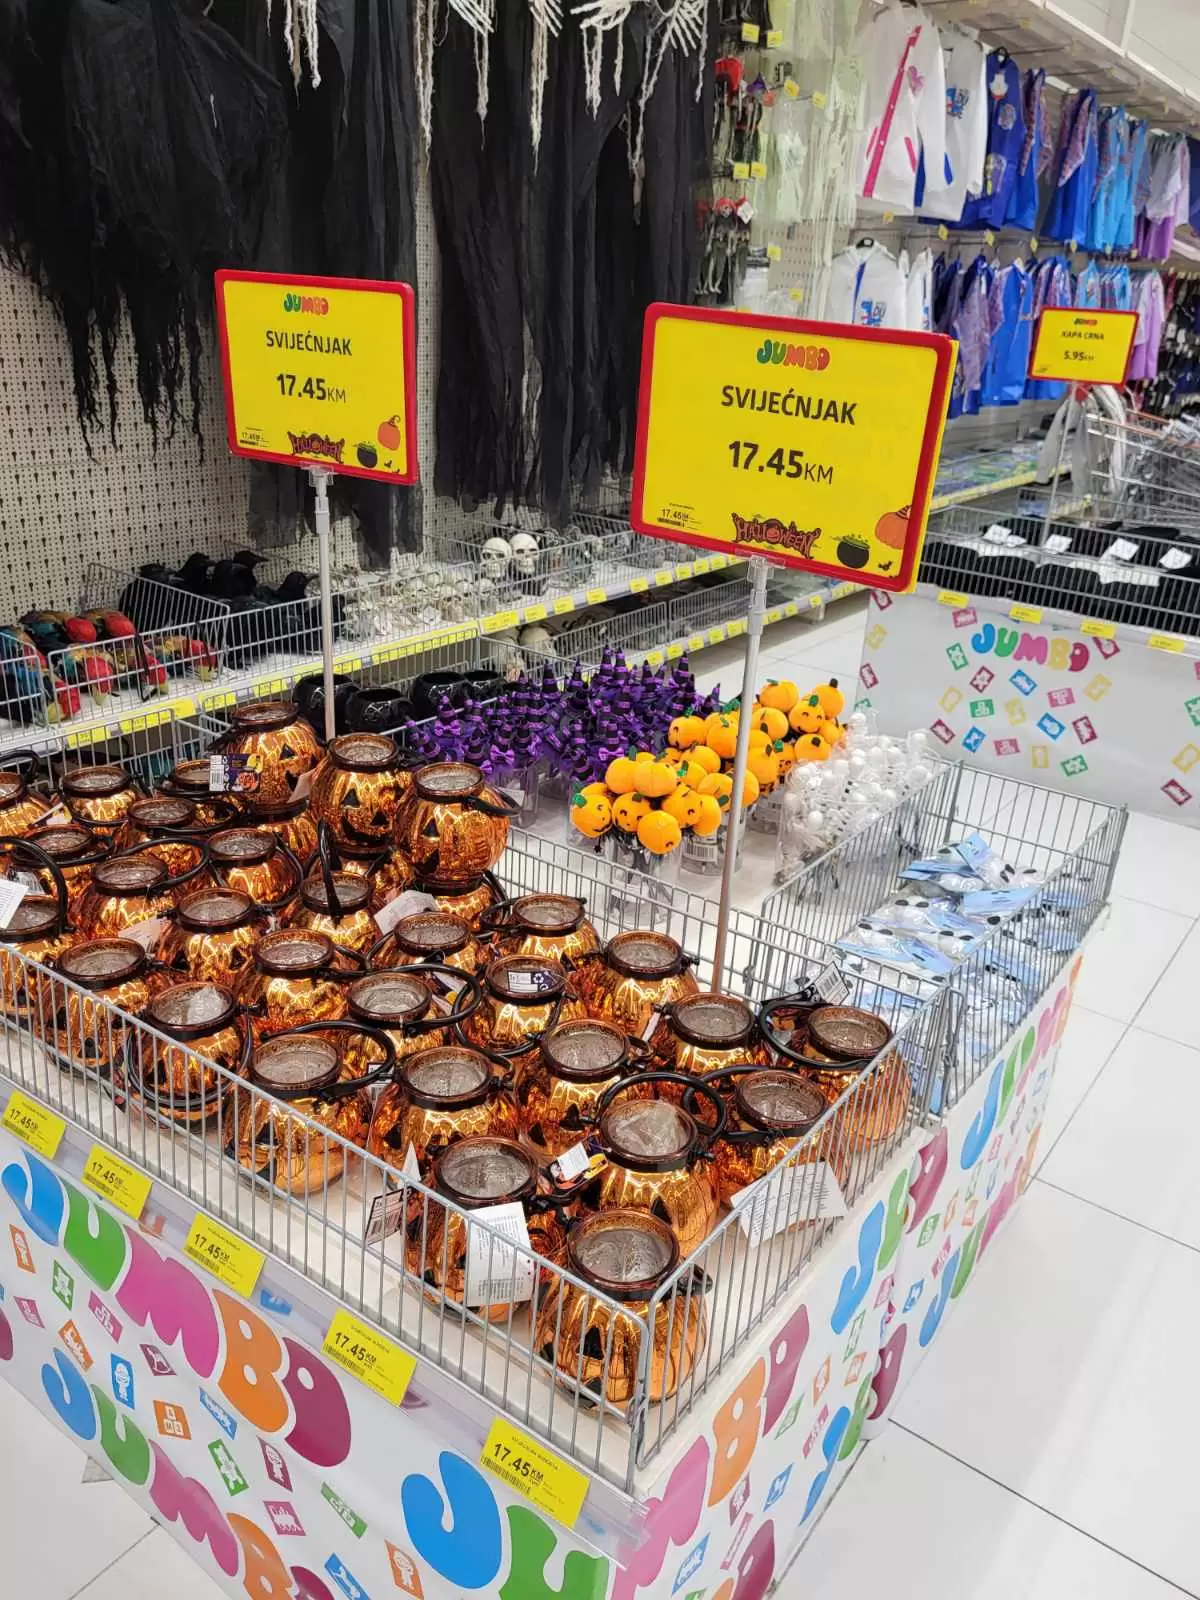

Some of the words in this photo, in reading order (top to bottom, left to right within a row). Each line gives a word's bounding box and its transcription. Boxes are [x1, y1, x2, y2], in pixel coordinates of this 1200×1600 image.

[283, 293, 329, 316] JUMBO
[266, 330, 352, 356] SVIJEĆNJAK
[757, 339, 831, 371] JUMBO
[721, 385, 857, 425] SVIJEĆNJAK
[971, 623, 1090, 672] JUMBO
[194, 1232, 221, 1260] 17.45
[1, 1146, 352, 1467] JUMBO
[335, 1331, 366, 1361] 17.45
[493, 1442, 531, 1477] 17.45
